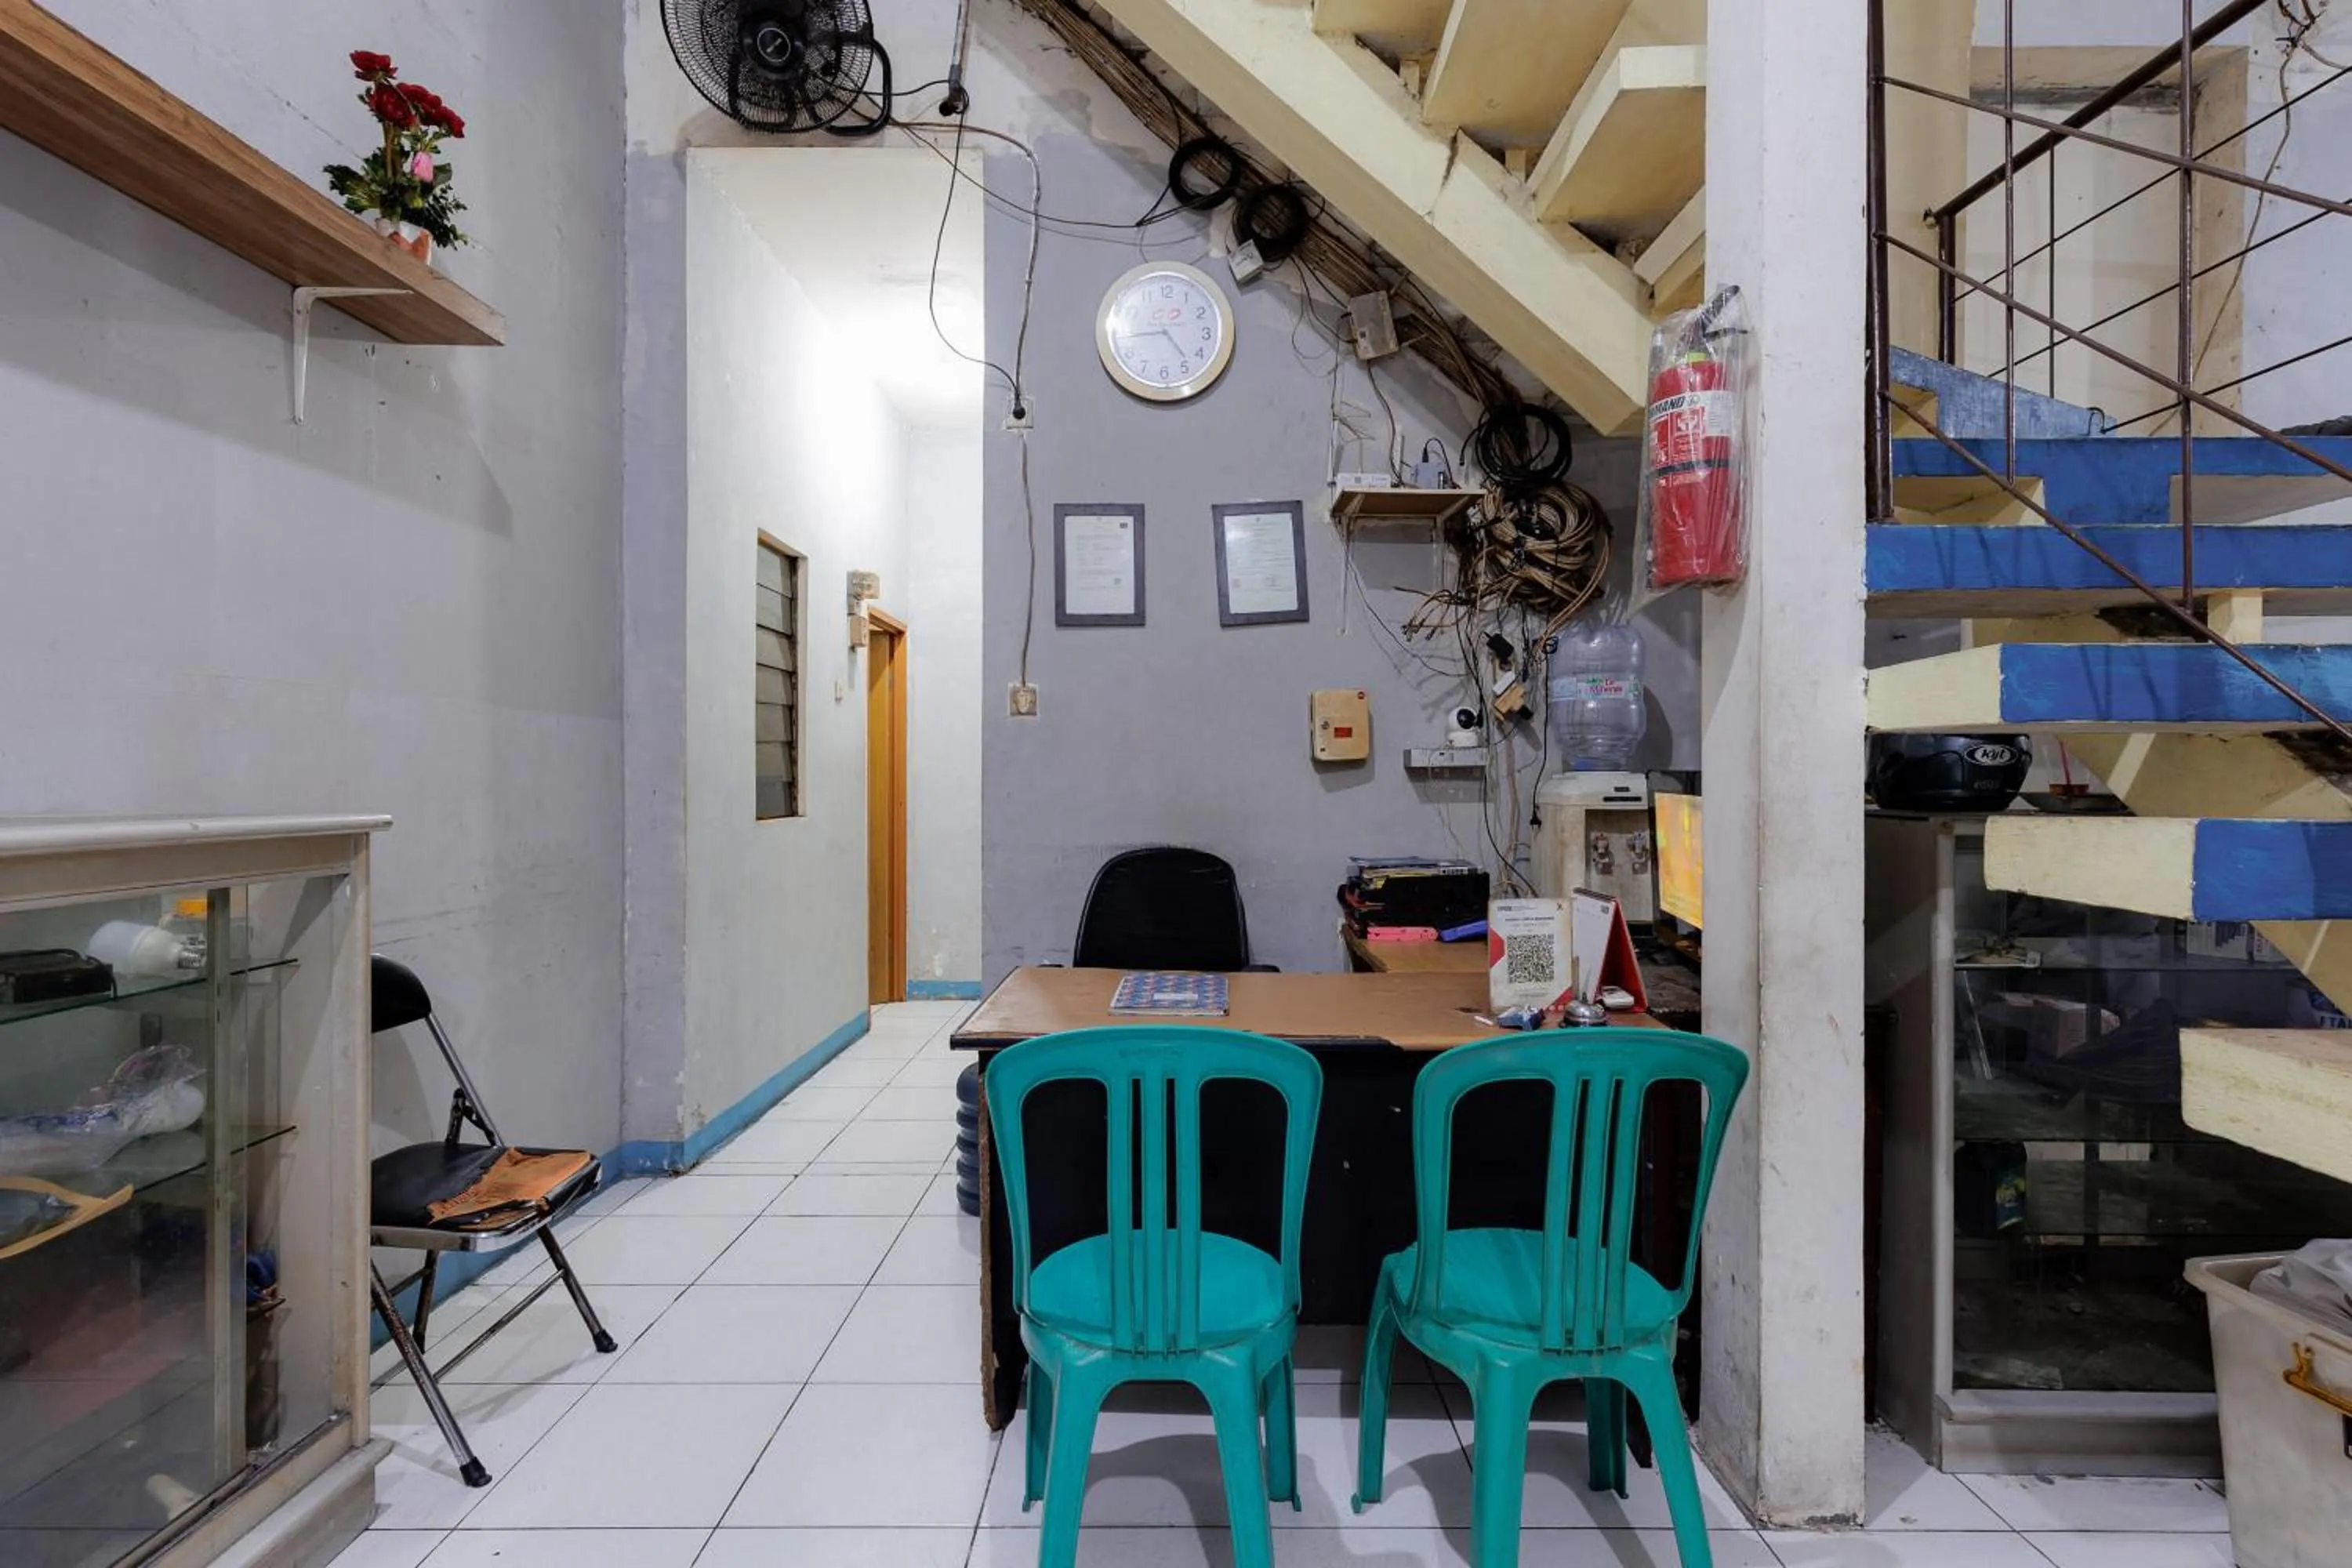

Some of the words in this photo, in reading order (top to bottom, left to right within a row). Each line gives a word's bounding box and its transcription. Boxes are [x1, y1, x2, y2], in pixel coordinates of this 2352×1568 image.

[1142, 290, 1152, 302] 11
[1161, 285, 1173, 298] 12
[1196, 307, 1206, 319] 2
[1202, 327, 1211, 340] 3
[1195, 347, 1204, 359] 4
[1141, 361, 1149, 373] 7
[1160, 366, 1169, 379] 6
[1180, 361, 1189, 374] 5
